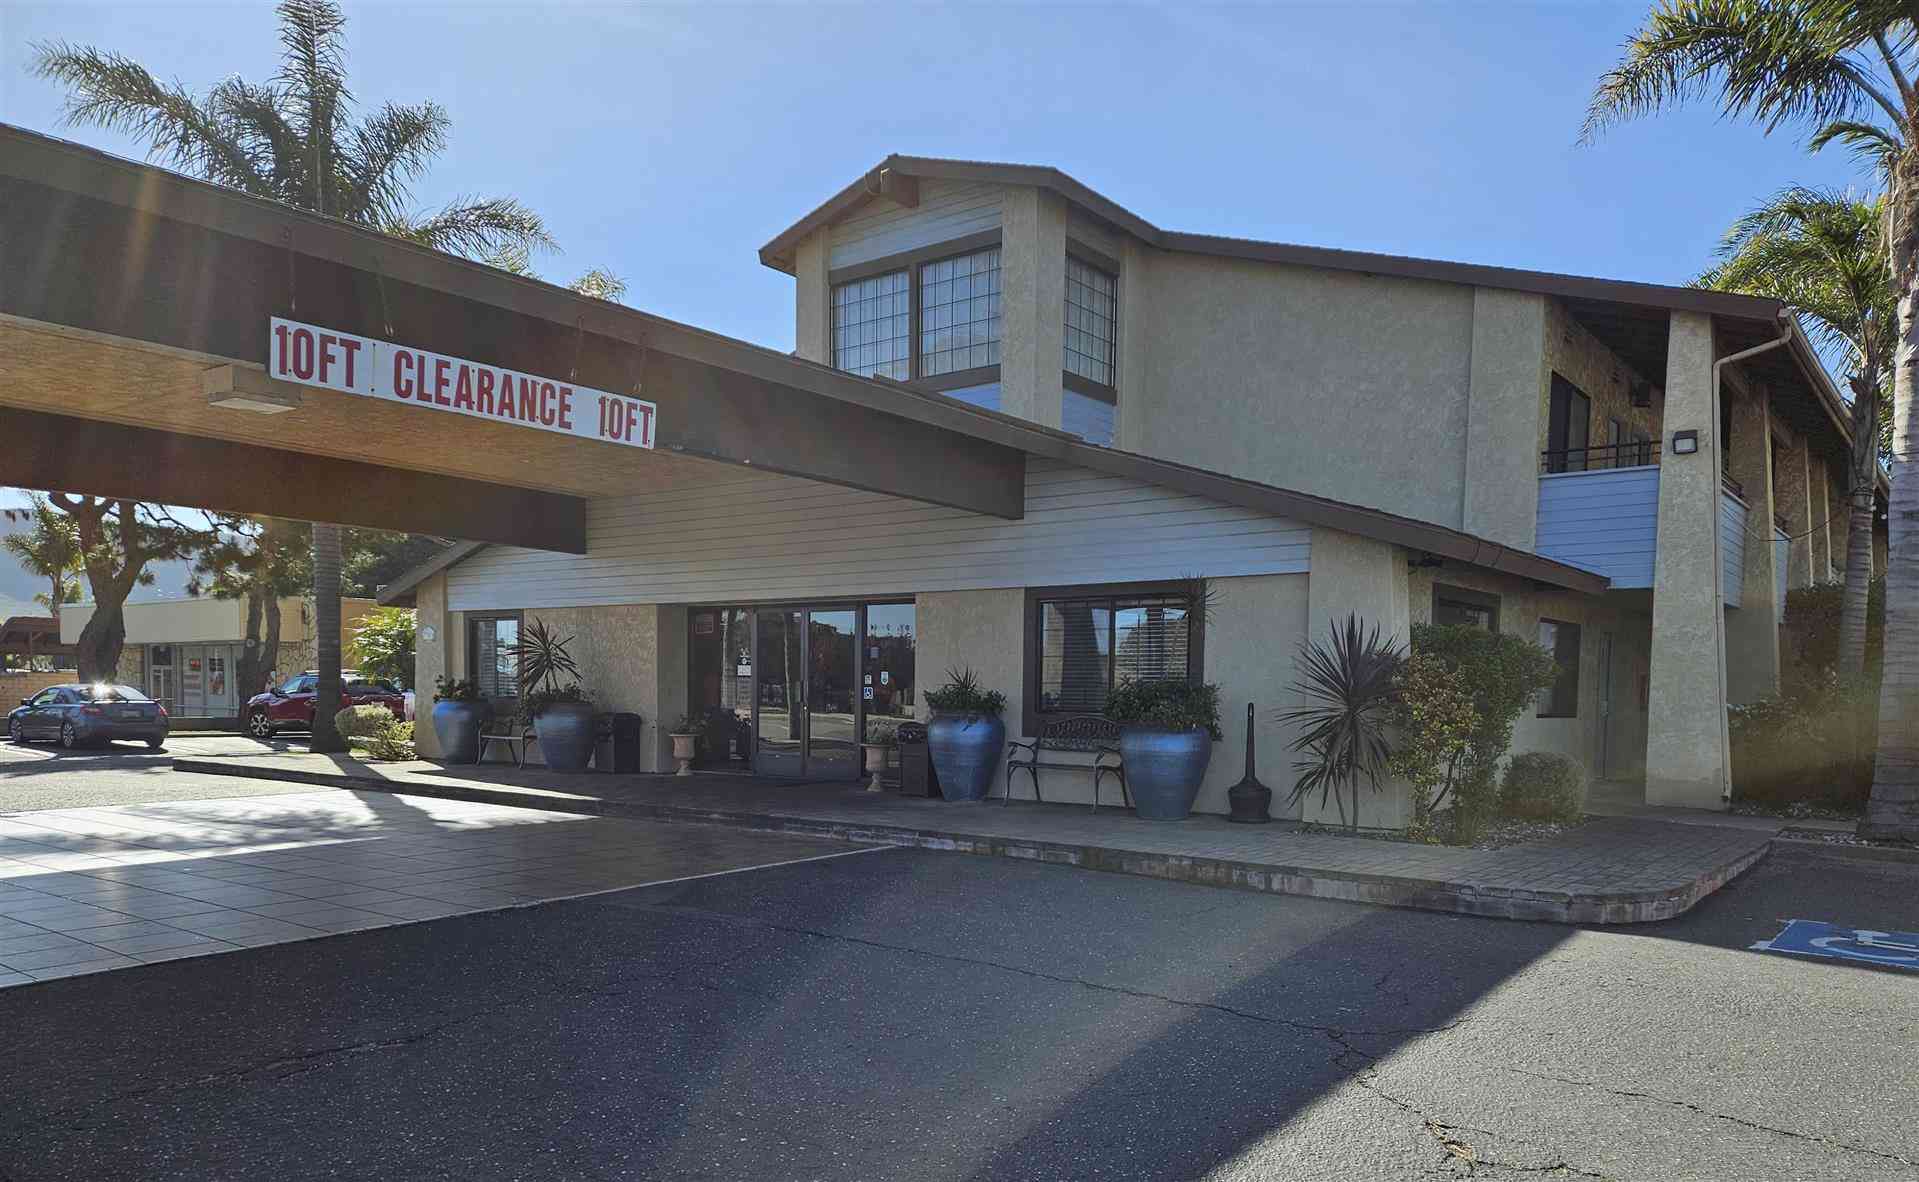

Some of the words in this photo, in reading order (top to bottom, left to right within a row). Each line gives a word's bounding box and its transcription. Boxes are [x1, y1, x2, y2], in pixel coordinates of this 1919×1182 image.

[275, 324, 361, 388] 10FT
[394, 350, 573, 430] CLEARANCE
[599, 396, 653, 445] 10FT
